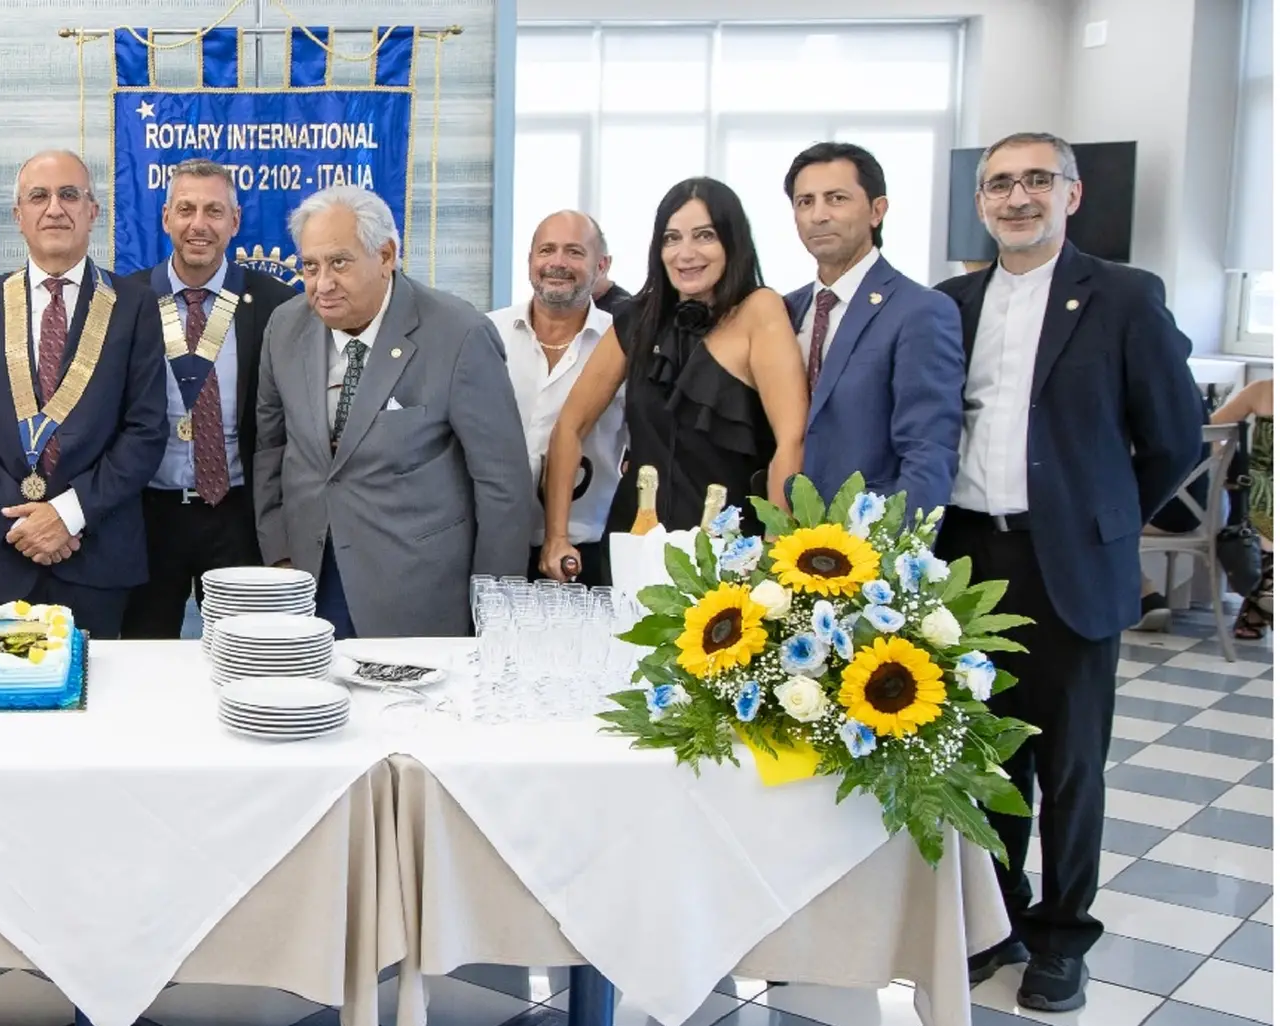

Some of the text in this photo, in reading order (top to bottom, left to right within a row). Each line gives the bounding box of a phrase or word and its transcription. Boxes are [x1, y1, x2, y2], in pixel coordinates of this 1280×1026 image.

[145, 122, 378, 150] ROTARY INTERNATIONAL
[258, 164, 301, 190] 2102
